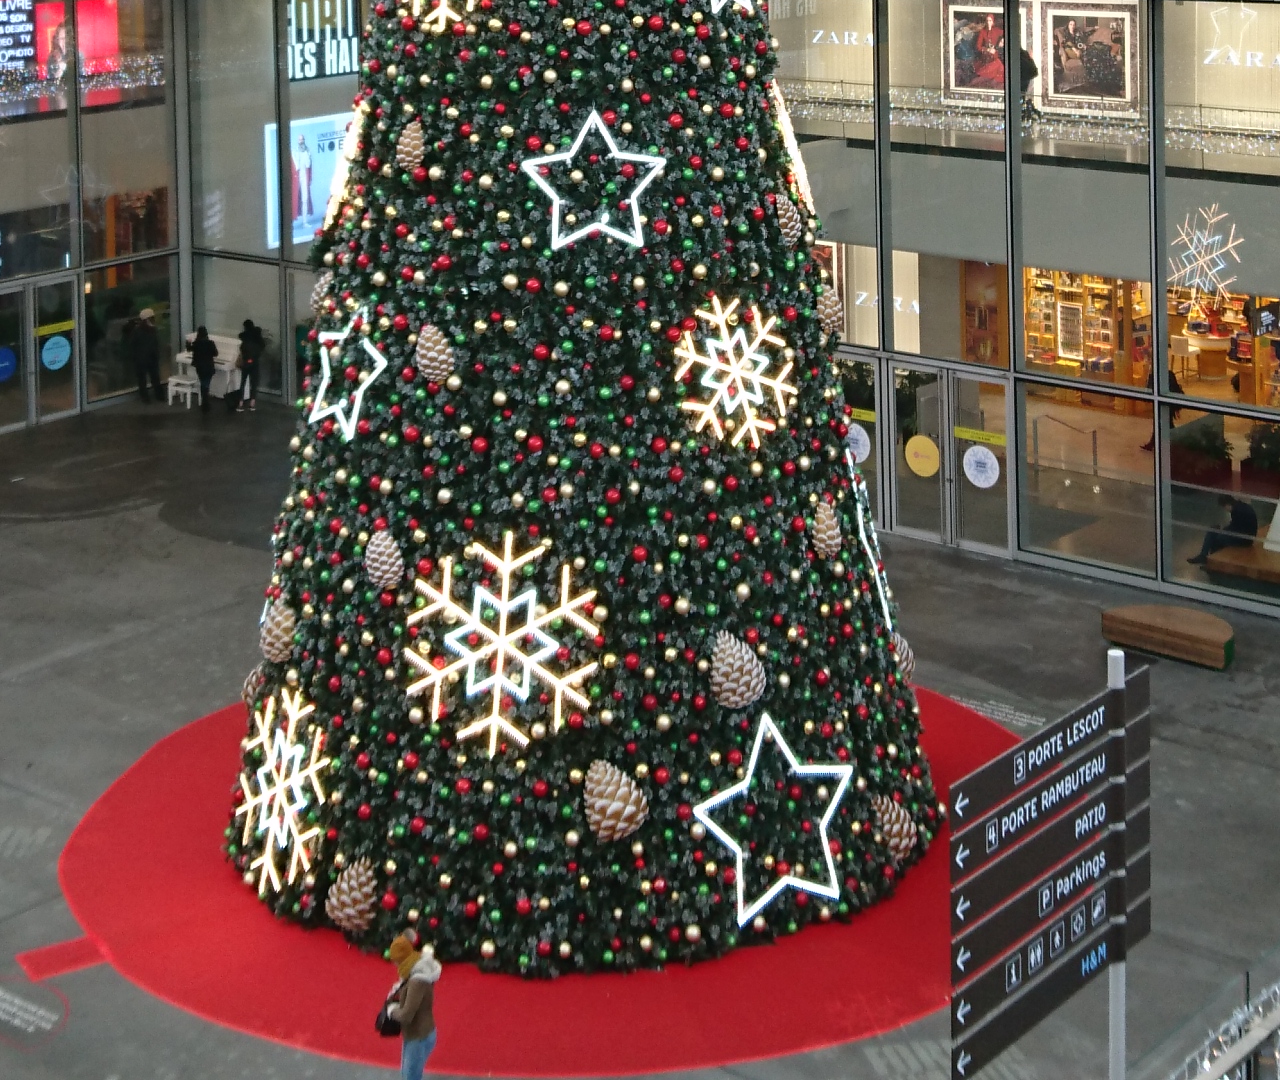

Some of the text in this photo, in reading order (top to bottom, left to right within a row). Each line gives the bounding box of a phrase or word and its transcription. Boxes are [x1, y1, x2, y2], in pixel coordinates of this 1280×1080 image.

[5, 23, 33, 34] DESIGN
[9, 13, 26, 23] SON
[8, 47, 34, 58] PHOTO
[21, 34, 32, 44] TV
[1028, 732, 1063, 771] PORTE
[1066, 705, 1106, 748] LESCOT
[1001, 796, 1038, 839] PORTE
[1041, 752, 1106, 812] RAMBUTEAU
[1074, 801, 1106, 840] PATIO
[1056, 850, 1106, 899] Parkings
[1081, 941, 1108, 978] H&M
